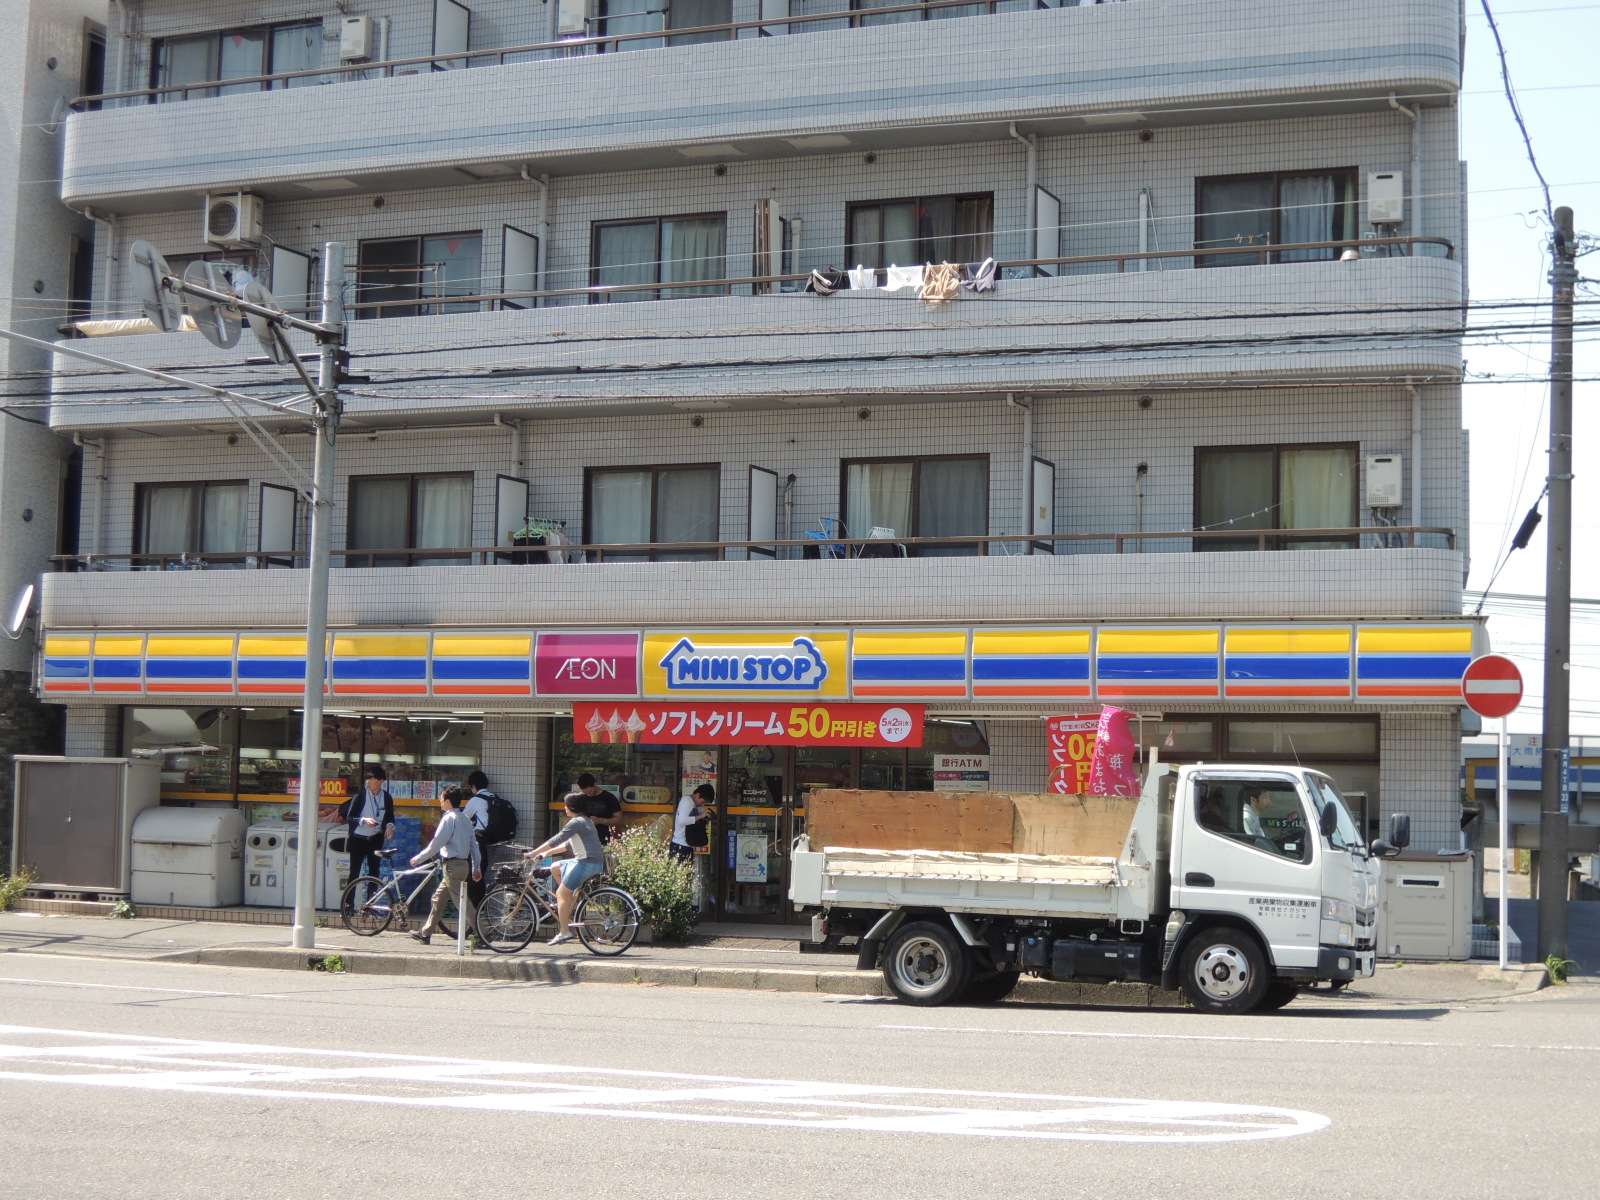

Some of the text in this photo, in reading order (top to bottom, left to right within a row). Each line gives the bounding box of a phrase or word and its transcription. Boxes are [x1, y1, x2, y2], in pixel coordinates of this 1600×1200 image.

[678, 655, 811, 682] MINI STOP
[648, 707, 878, 739] ソフトクリーム50円引き
[881, 717, 912, 727] 5月2日(水)
[941, 758, 983, 768] 銀行ATM
[1248, 897, 1317, 908] 産業廃棄物収集運搬車
